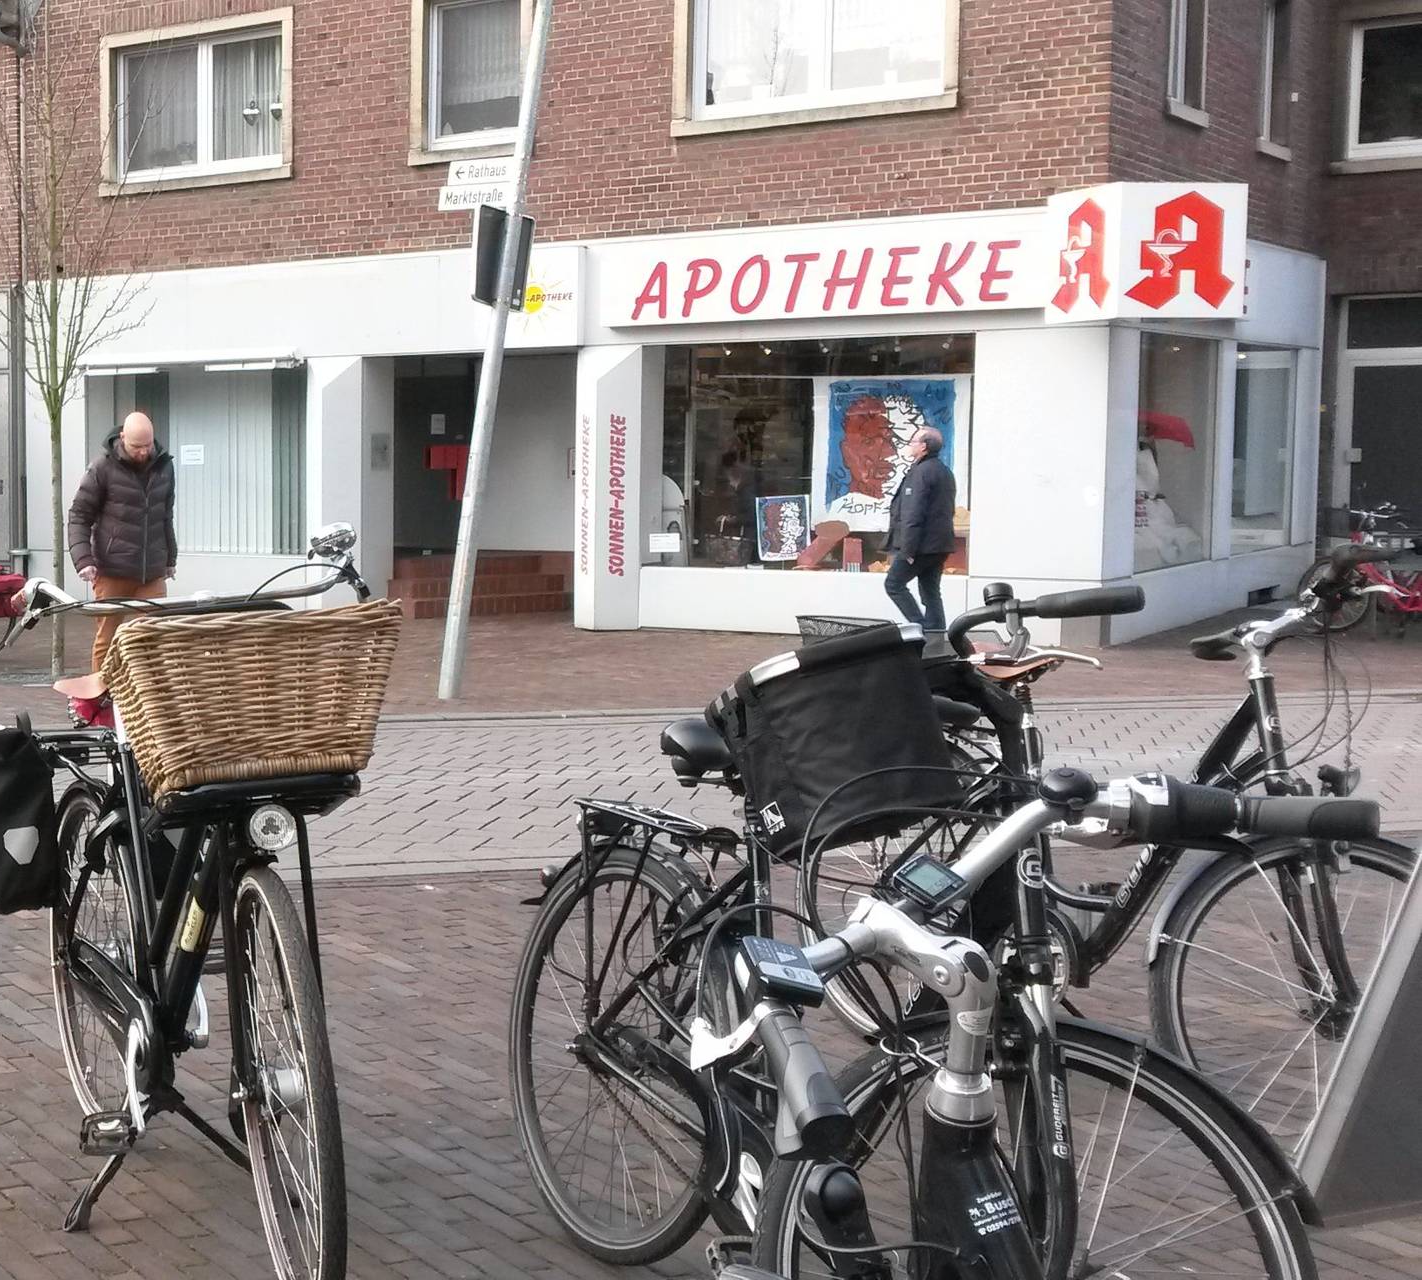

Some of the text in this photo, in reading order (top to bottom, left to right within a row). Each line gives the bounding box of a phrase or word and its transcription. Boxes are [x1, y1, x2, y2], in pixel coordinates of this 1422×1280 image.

[444, 188, 503, 205] Marktstraße
[467, 164, 507, 179] Rathaus
[631, 240, 1021, 320] APOTHEKE
[1123, 190, 1235, 310] A
[580, 413, 591, 576] SONNEN-APOTHEKE
[608, 413, 627, 577] SONNEN-APOTHEKE
[984, 1197, 1015, 1214] Busc
